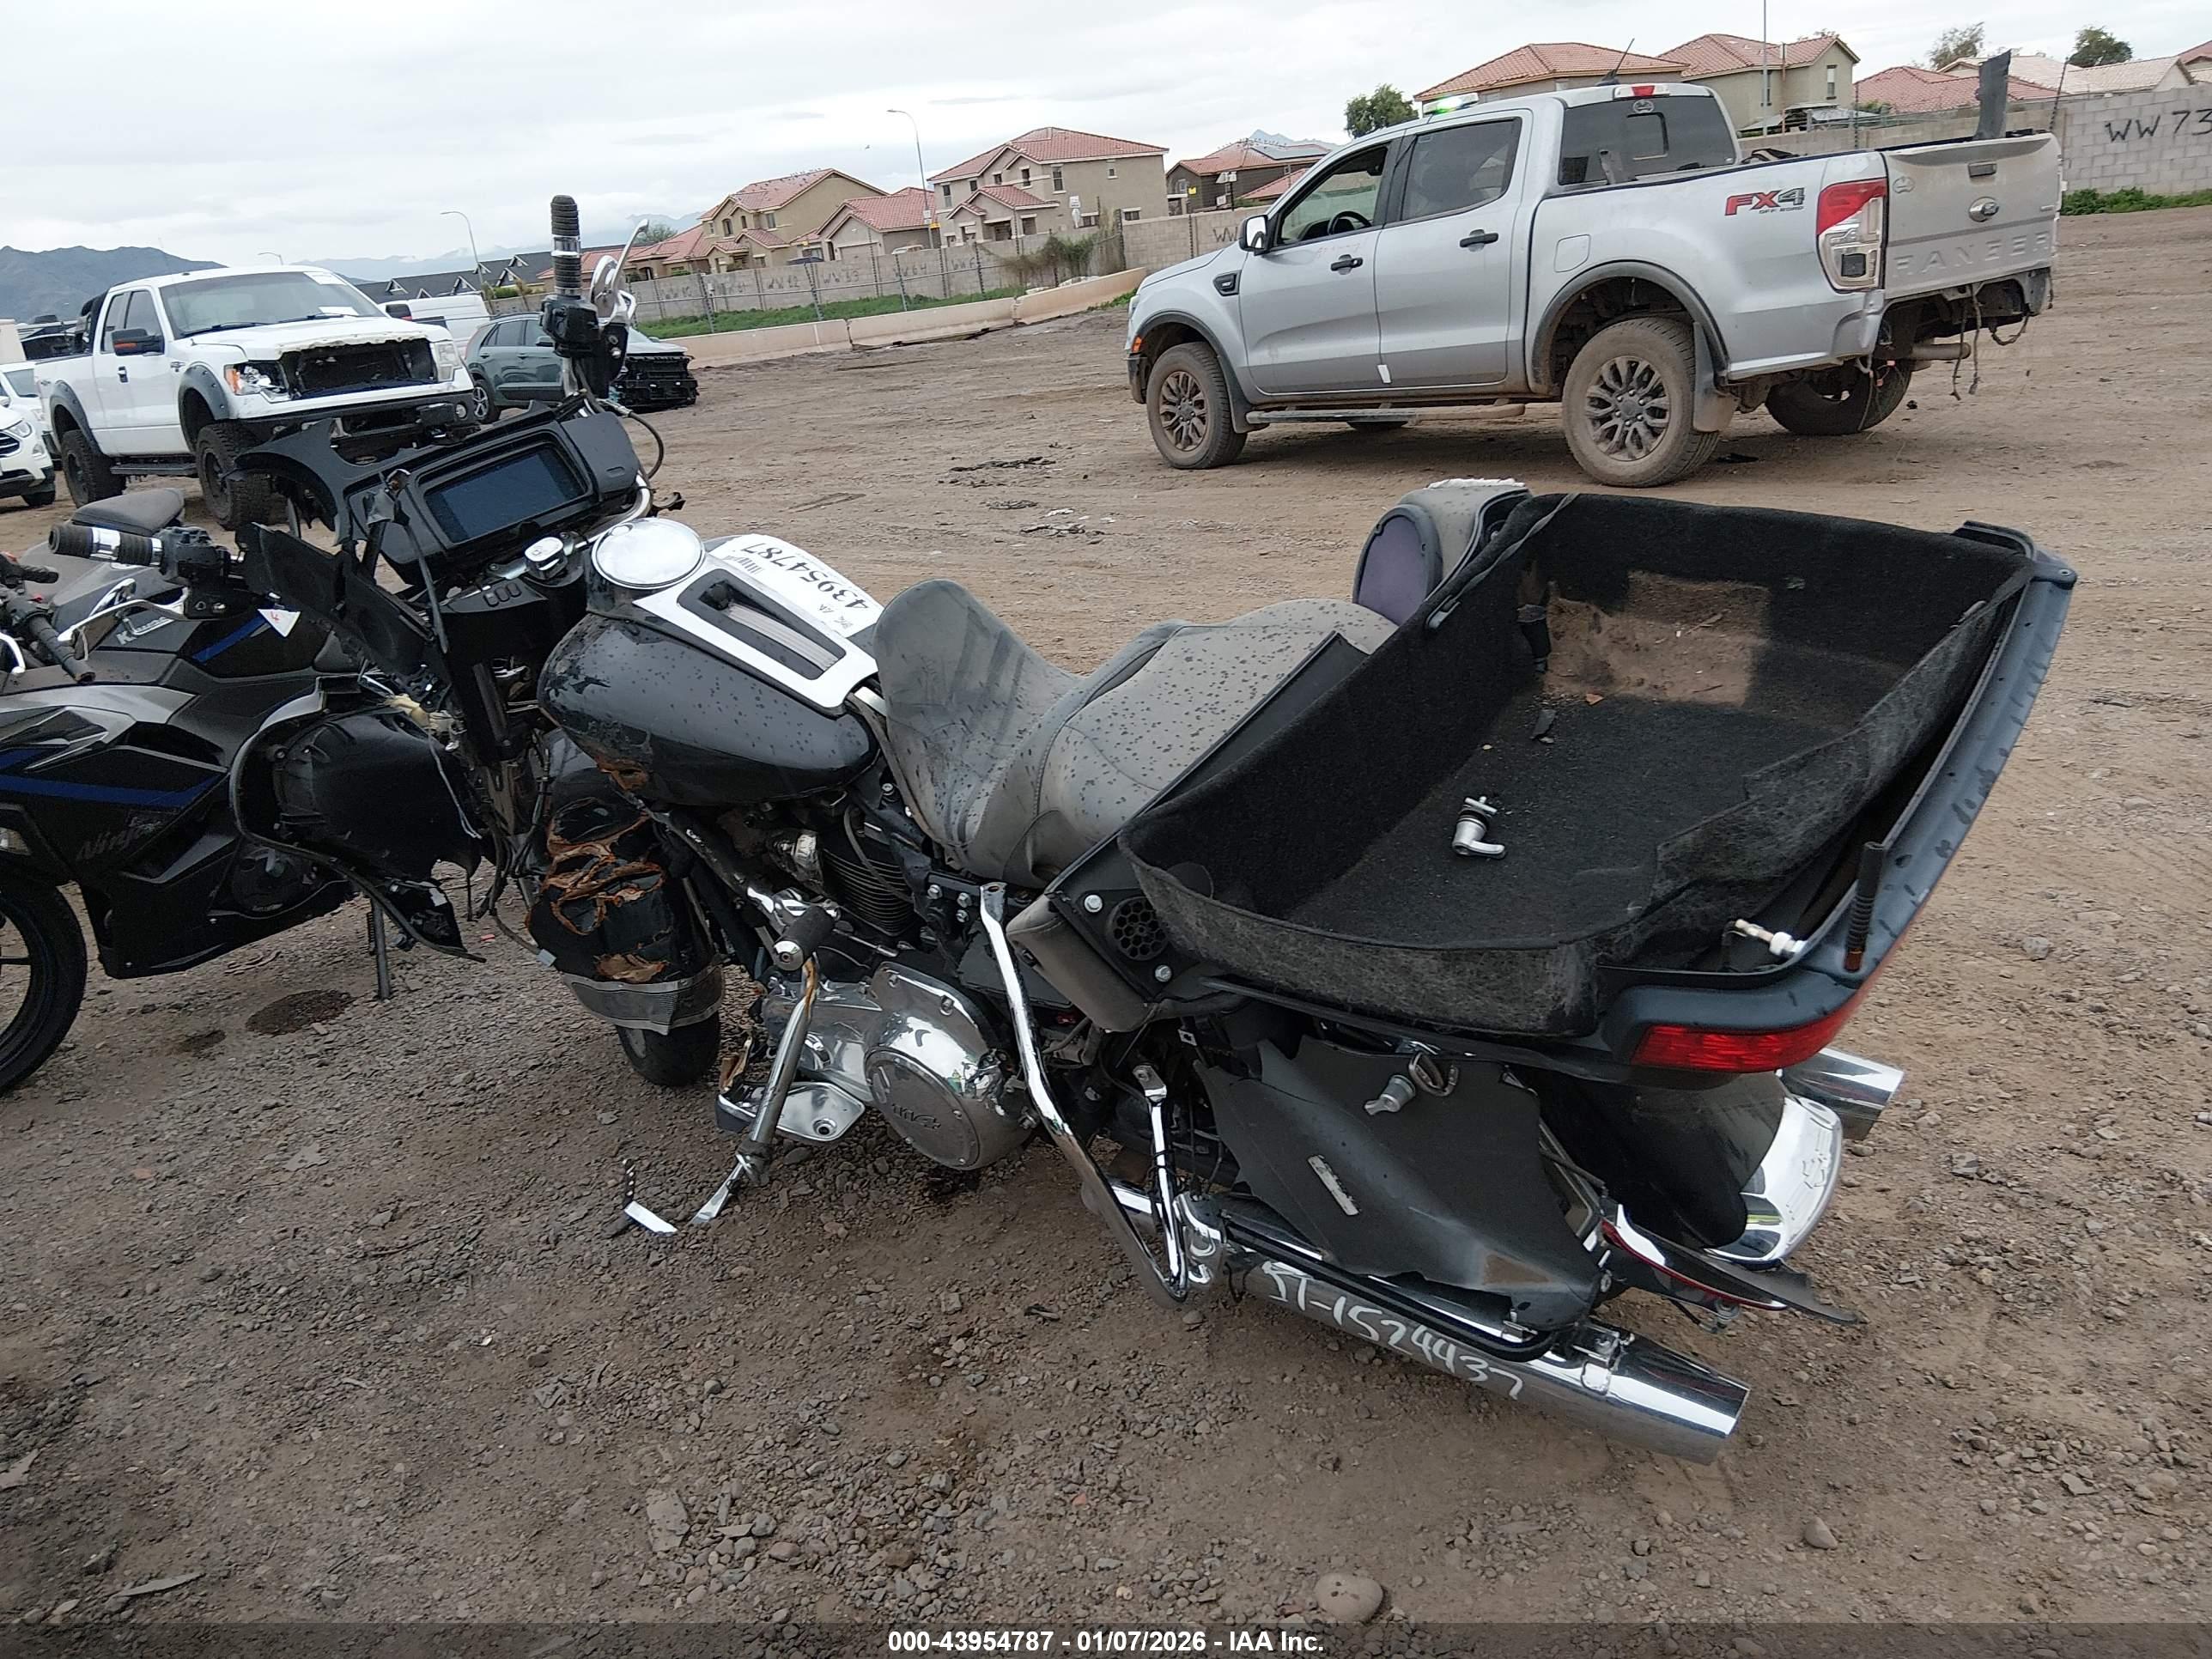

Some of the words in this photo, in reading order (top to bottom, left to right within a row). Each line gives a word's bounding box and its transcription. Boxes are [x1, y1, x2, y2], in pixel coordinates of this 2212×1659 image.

[2105, 114, 2160, 143] WW
[1724, 187, 1805, 216] FX4
[740, 543, 869, 610] 43954787
